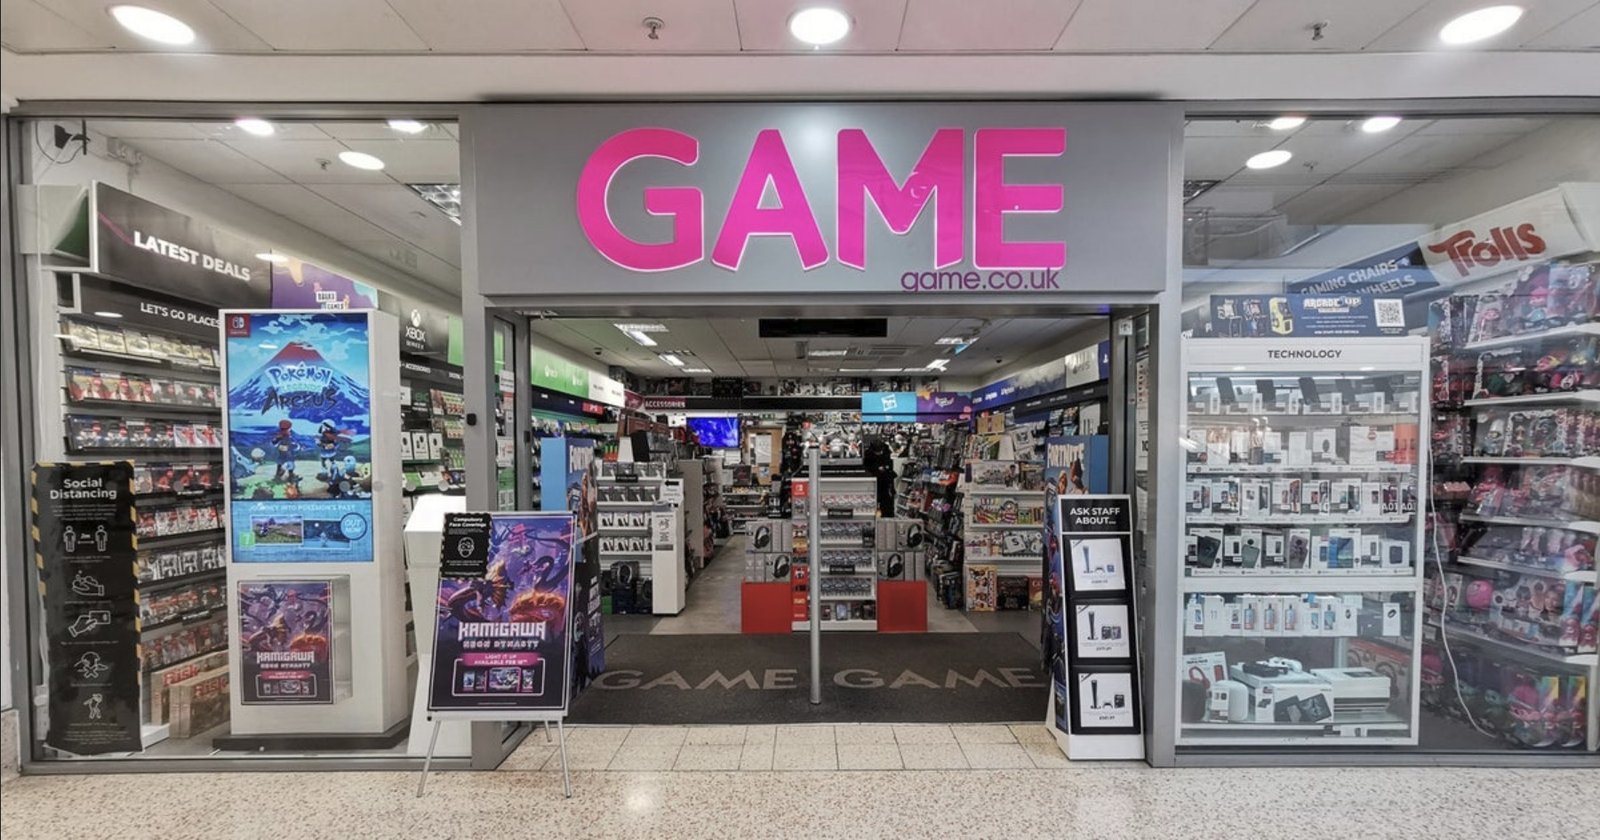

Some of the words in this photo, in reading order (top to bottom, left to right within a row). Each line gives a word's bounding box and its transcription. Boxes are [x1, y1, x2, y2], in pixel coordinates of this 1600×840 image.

[577, 127, 1067, 272] GAME
[133, 231, 199, 265] LATEST
[202, 254, 250, 282] DEALS
[1428, 223, 1547, 277] Trolls
[901, 267, 1060, 293] game.co.uk
[1301, 276, 1347, 295] GAMING
[1348, 259, 1399, 284] CHAIRS
[140, 302, 169, 317] LET'S
[170, 309, 186, 321] GO
[405, 325, 426, 343] XBOX
[1268, 350, 1342, 359] TECHNOLOGY
[645, 400, 686, 408] ACCESSORIES
[63, 478, 102, 489] Social
[50, 489, 117, 500] Distancing
[1070, 507, 1090, 516] ASK
[1091, 507, 1120, 516] STAFF
[1075, 516, 1116, 525] ABOUT...
[463, 640, 491, 649] NEON
[494, 640, 539, 649] DYNASTY
[163, 664, 200, 687] Risk
[599, 668, 798, 691] GAME
[833, 667, 1047, 689] GAME
